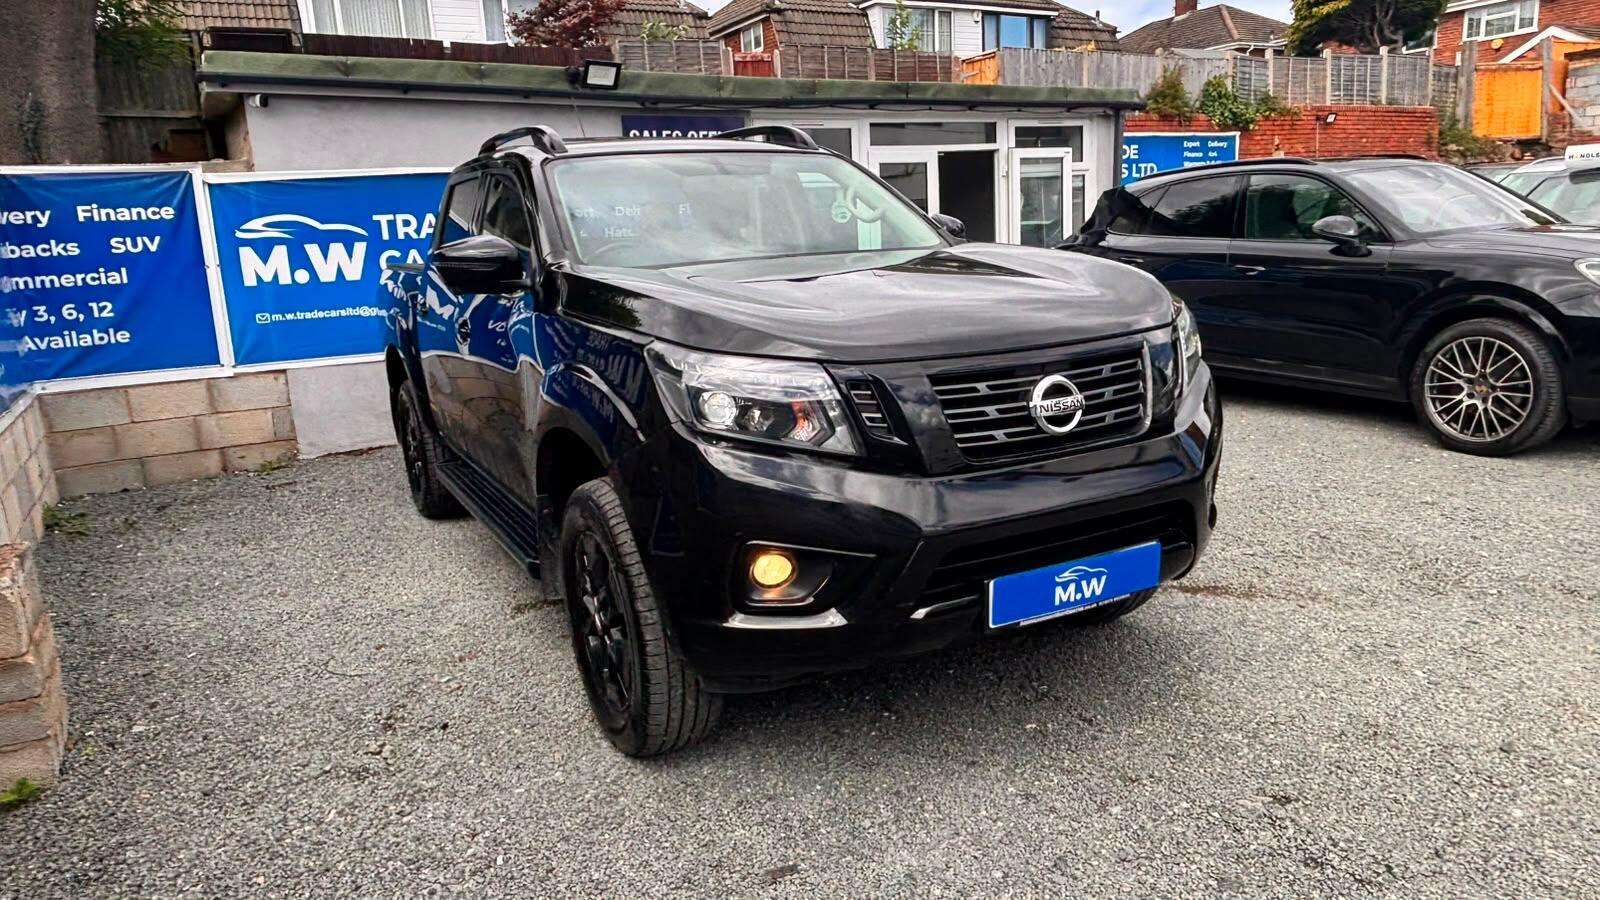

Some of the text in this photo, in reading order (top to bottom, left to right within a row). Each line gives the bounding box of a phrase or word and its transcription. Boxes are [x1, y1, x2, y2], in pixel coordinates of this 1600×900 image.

[1183, 150, 1204, 158] Finance
[1131, 162, 1158, 178] LTD
[76, 203, 175, 222] Finance
[372, 212, 436, 241] TRA
[109, 235, 161, 254] SUV
[238, 241, 368, 287] M.W
[32, 305, 56, 324] 3,
[61, 303, 85, 322] 6,
[88, 301, 115, 318] 12
[22, 327, 131, 352] Available
[1040, 398, 1083, 414] NISSAN
[1054, 575, 1107, 606] M.W
